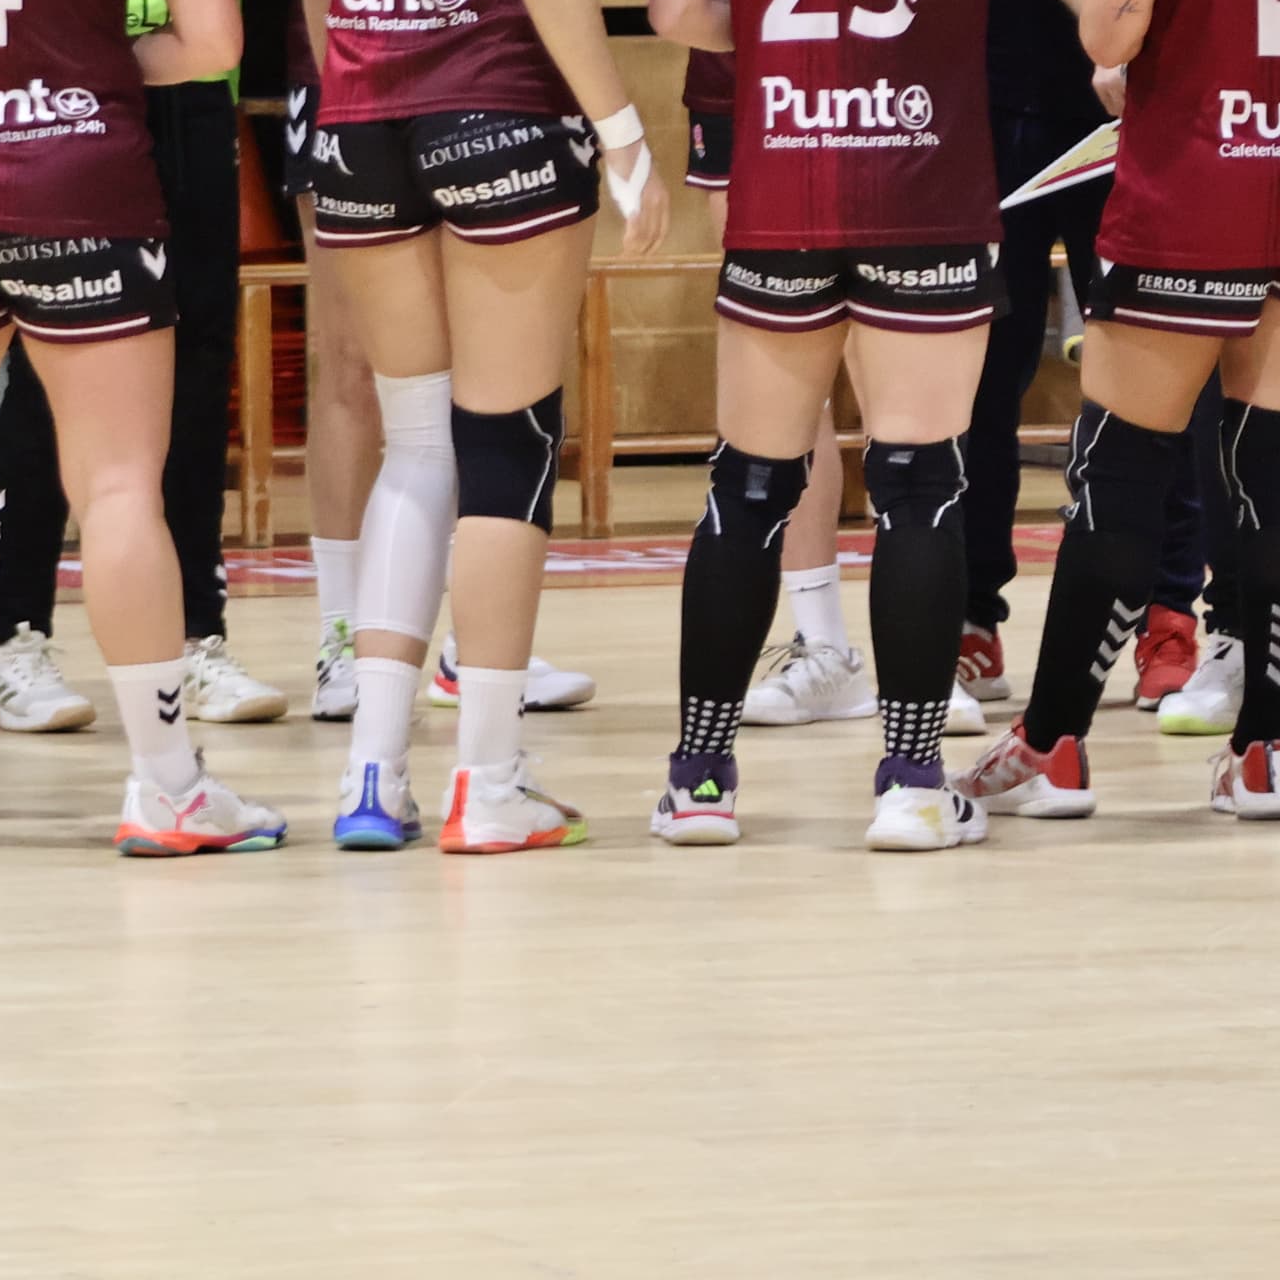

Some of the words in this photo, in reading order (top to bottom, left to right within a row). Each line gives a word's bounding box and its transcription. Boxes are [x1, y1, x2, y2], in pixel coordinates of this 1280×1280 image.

[419, 124, 546, 170] LOUISIANA
[821, 132, 912, 148] Restaurante
[433, 159, 558, 207] Dissalud
[0, 270, 124, 303] Dissalud
[856, 257, 978, 287] Dissalud
[1136, 273, 1197, 294] FERROS
